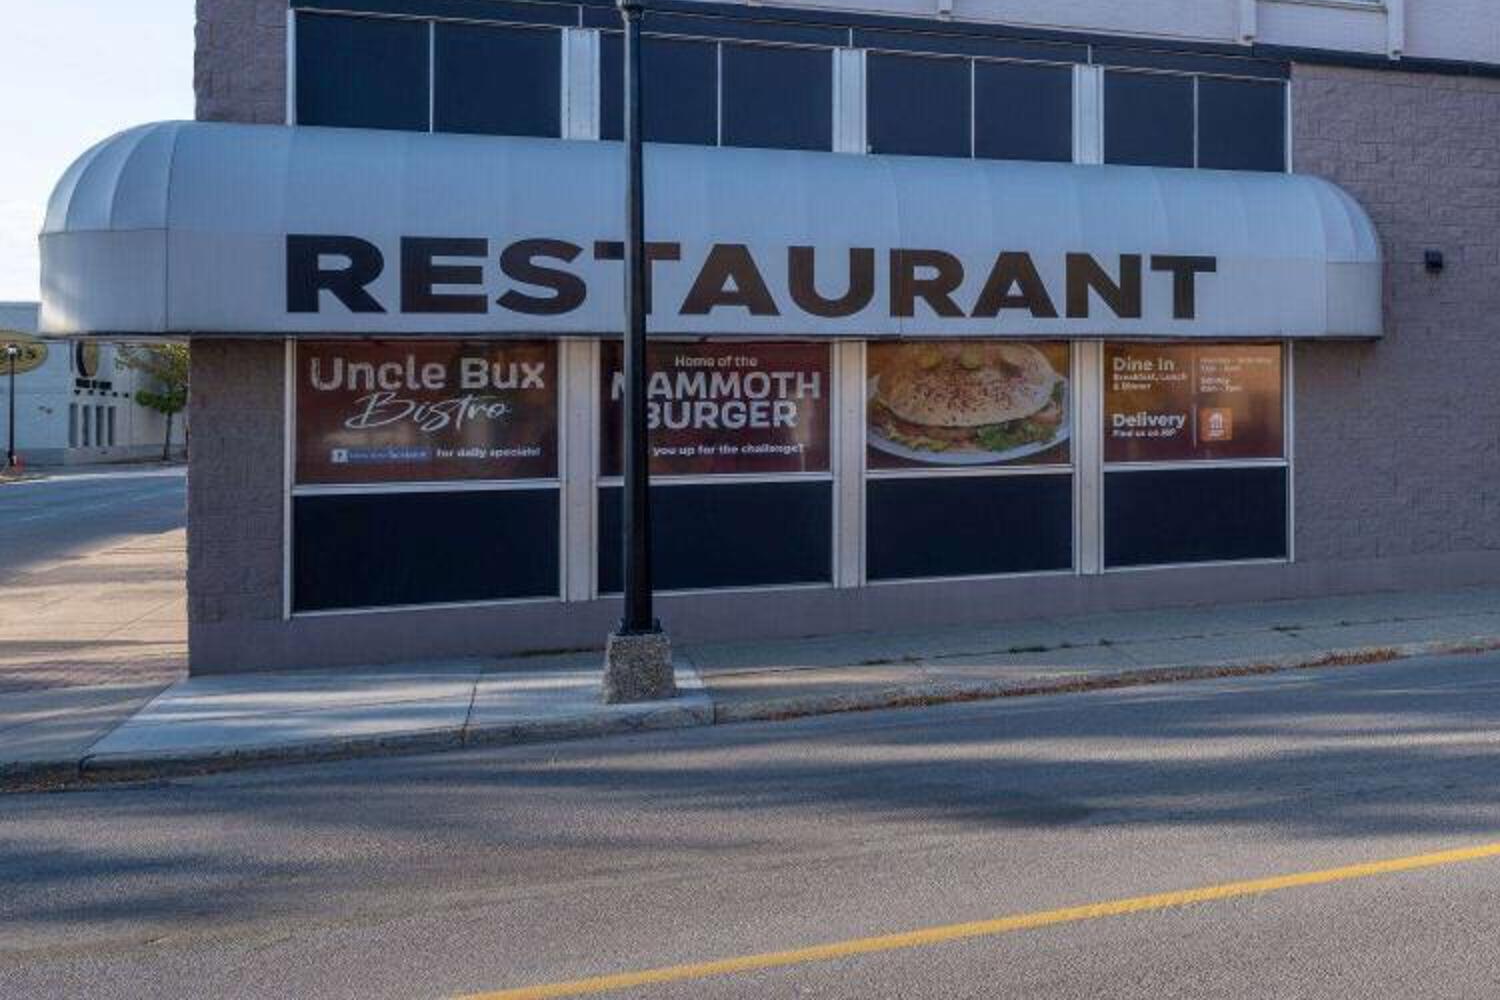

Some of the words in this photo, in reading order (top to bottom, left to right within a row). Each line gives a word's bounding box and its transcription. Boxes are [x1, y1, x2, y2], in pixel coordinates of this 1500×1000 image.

[286, 233, 1217, 321] RESTAURANT
[675, 355, 714, 368] Home
[717, 355, 732, 368] of
[734, 354, 758, 368] the
[1112, 355, 1153, 372] Dine
[1158, 356, 1175, 371] In
[310, 355, 448, 391] Uncle
[460, 356, 546, 390] Bux
[344, 391, 511, 431] Bistro
[1112, 411, 1186, 429] Delivery
[437, 447, 453, 457] for
[457, 447, 487, 459] daily
[653, 445, 676, 457] you
[679, 445, 695, 457] up
[698, 444, 715, 455] for
[719, 443, 739, 455] the
[741, 443, 804, 455] challenge?
